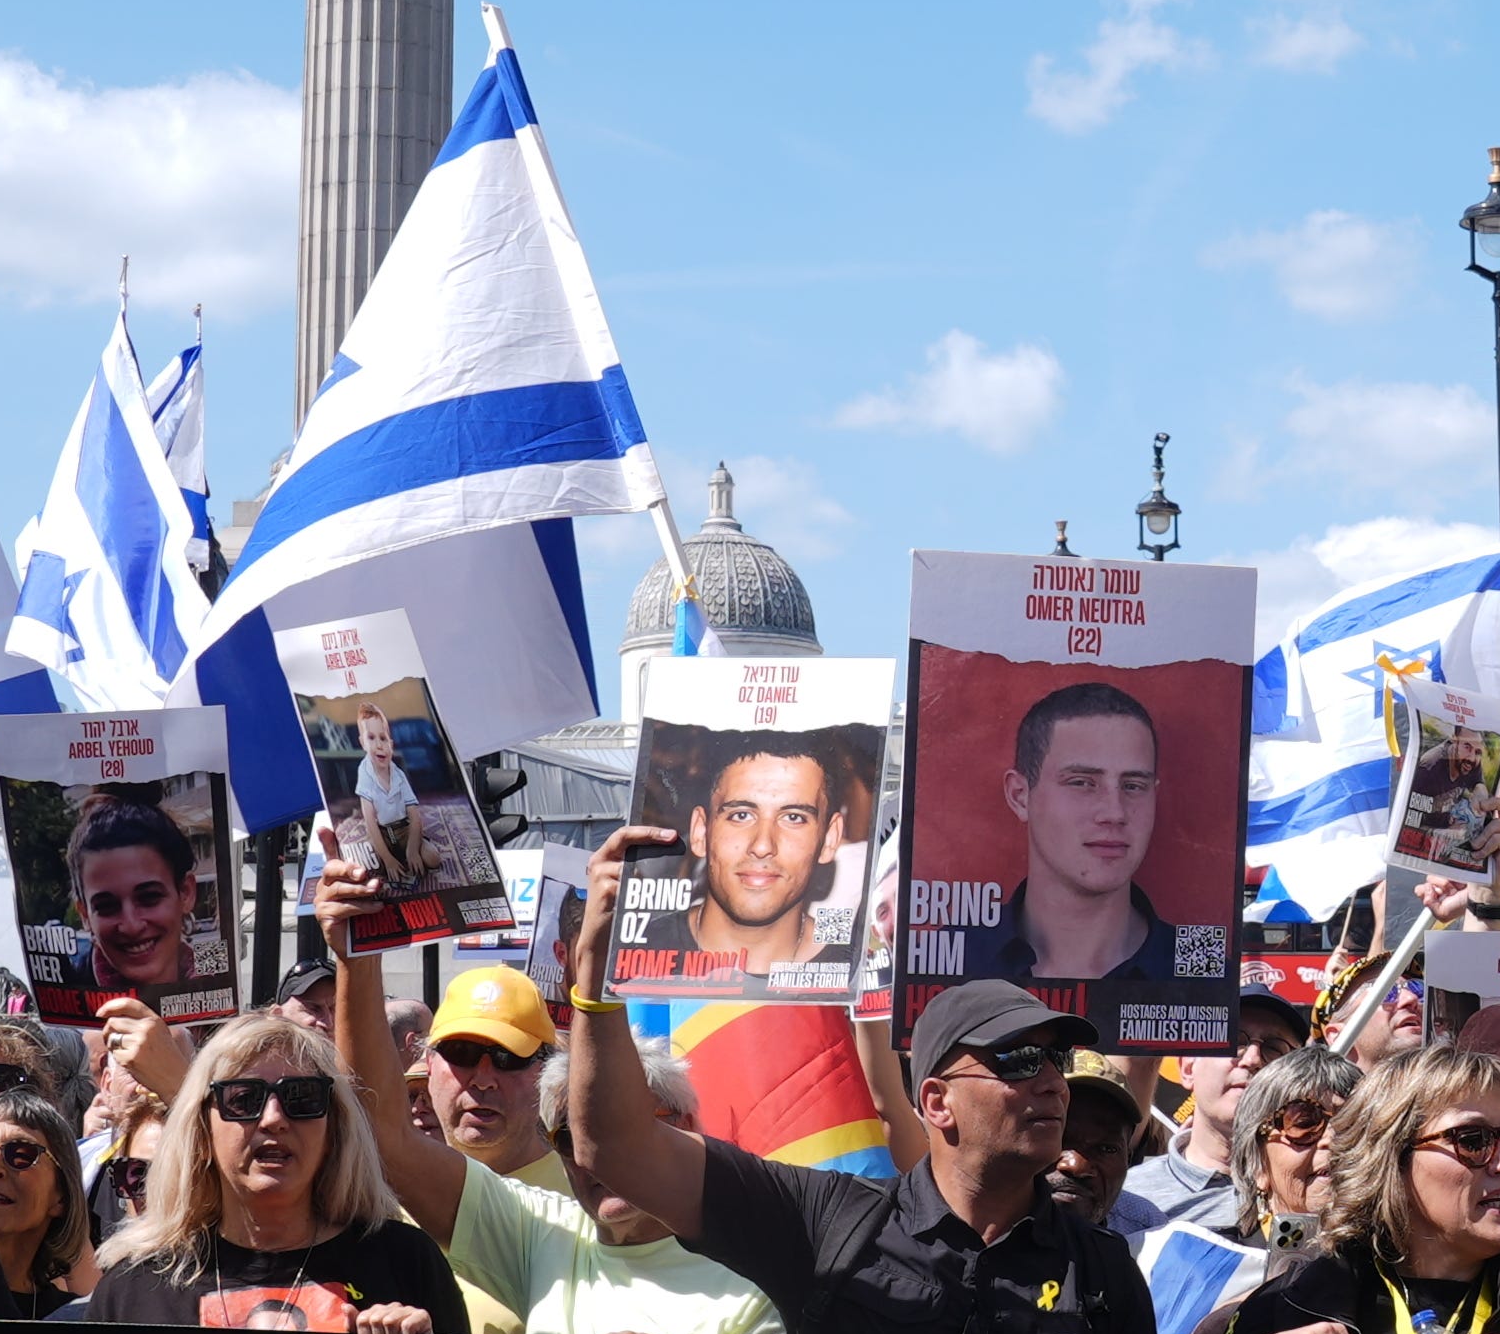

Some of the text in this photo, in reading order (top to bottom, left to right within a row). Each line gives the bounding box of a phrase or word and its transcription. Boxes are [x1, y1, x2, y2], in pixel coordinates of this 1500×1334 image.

[1032, 564, 1095, 594] נאוטרה
[1026, 594, 1146, 625] OMER NEUTRA
[1067, 626, 1102, 656] (22)
[737, 686, 798, 704] OZ DANIEL
[753, 705, 778, 726] (19)
[68, 738, 155, 760] ARBEL YEHOUD
[100, 759, 125, 779] (28)
[624, 877, 693, 912] BRING
[909, 880, 1002, 928] BRING
[22, 923, 78, 956] BRING
[620, 911, 652, 945] OZ
[613, 948, 681, 980] HOME
[906, 929, 965, 977] HIM
[29, 954, 64, 985] HER
[767, 971, 850, 989] FAMILIES FORUM
[200, 996, 236, 1014] FORUM
[1120, 1004, 1229, 1022] HOSTAGES AND MISSING
[1119, 1018, 1229, 1044] FAMILIES FORUM
